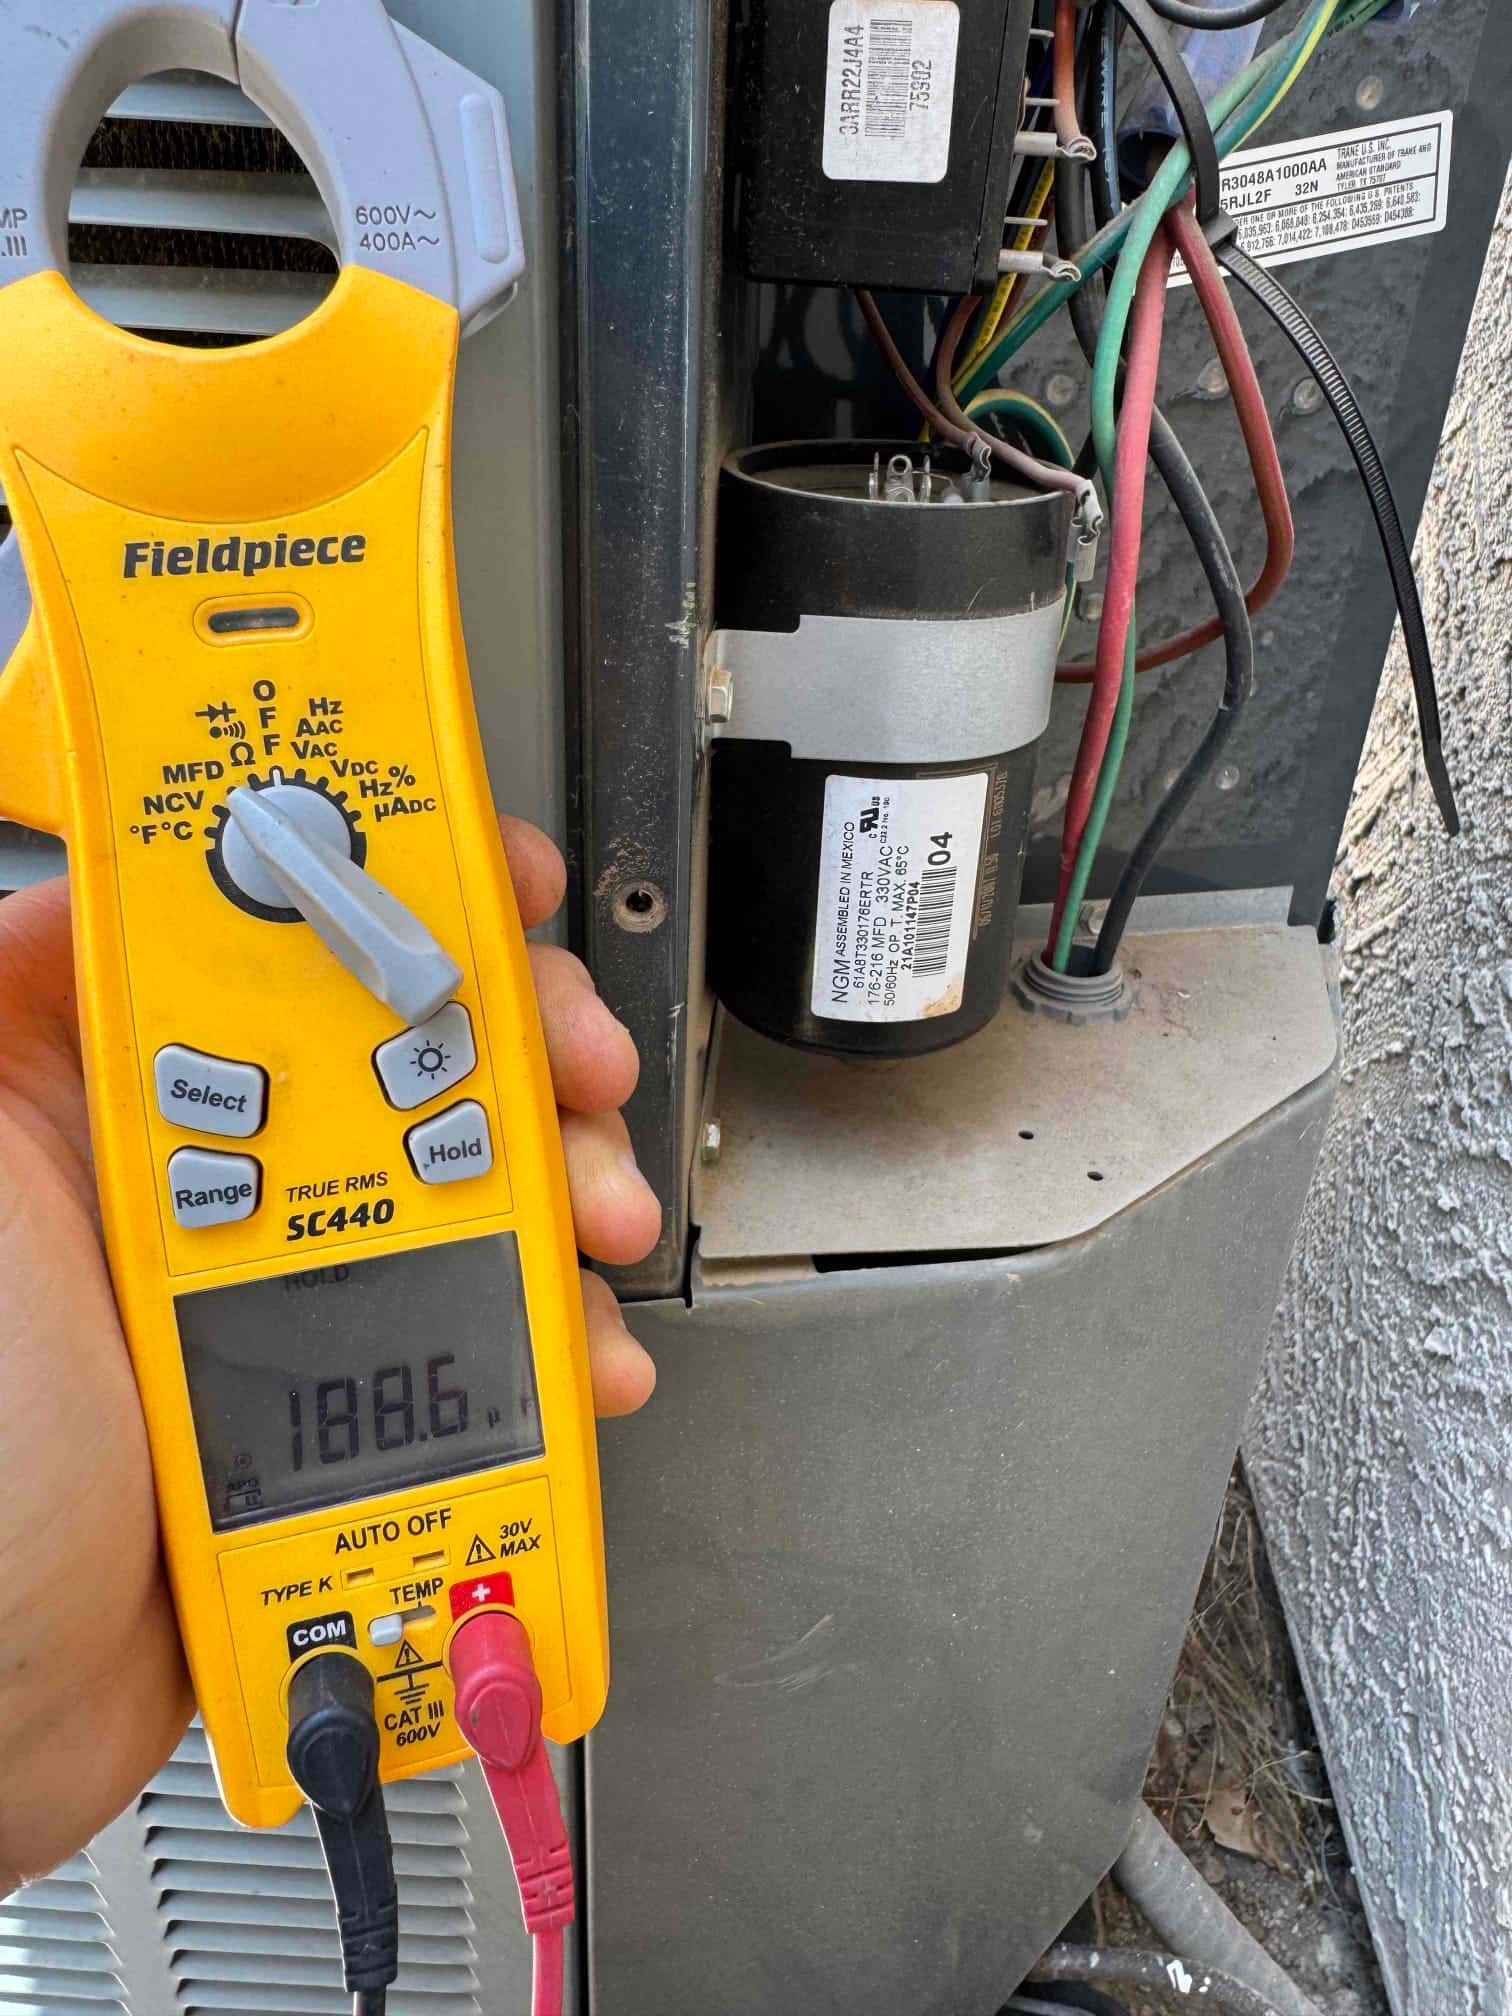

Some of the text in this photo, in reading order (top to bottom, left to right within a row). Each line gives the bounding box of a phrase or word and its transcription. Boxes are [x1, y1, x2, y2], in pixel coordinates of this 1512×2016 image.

[1337, 144, 1360, 160] TRANE
[1387, 149, 1396, 160] OF
[1221, 158, 1327, 192] R3048A1000AA
[1295, 180, 1319, 196] 32N
[1250, 213, 1264, 225] ONE
[1278, 206, 1298, 219] MORE
[1299, 202, 1309, 214] OF
[1311, 199, 1324, 211] THE
[123, 533, 367, 579] Fieldpiece
[309, 698, 343, 716] Hz
[163, 760, 224, 784] MFD
[143, 791, 205, 815] NCV
[360, 780, 394, 798] Hz
[927, 831, 953, 866] 04
[832, 822, 855, 1004] NGM ASSEMBLED IN MEXICO
[868, 846, 893, 1005] 176-216 MFD 330VAC
[902, 881, 920, 970] 21A101147P04
[884, 960, 898, 1006] 50/60Hz
[170, 1079, 248, 1114] Select
[428, 1138, 483, 1164] Hold
[175, 1180, 253, 1211] Range
[286, 1171, 389, 1203] TRUE RMS
[286, 1198, 395, 1241] SC440
[289, 1354, 469, 1472] 188.6
[334, 1508, 452, 1554] AUTO OFF
[500, 1519, 533, 1538] 30V
[500, 1534, 542, 1558] MAX
[261, 1576, 333, 1606] TYPE K
[389, 1577, 444, 1605] TEMP
[292, 1620, 347, 1646] COM
[384, 1700, 445, 1730] CAT III
[396, 1722, 442, 1746] 600V
